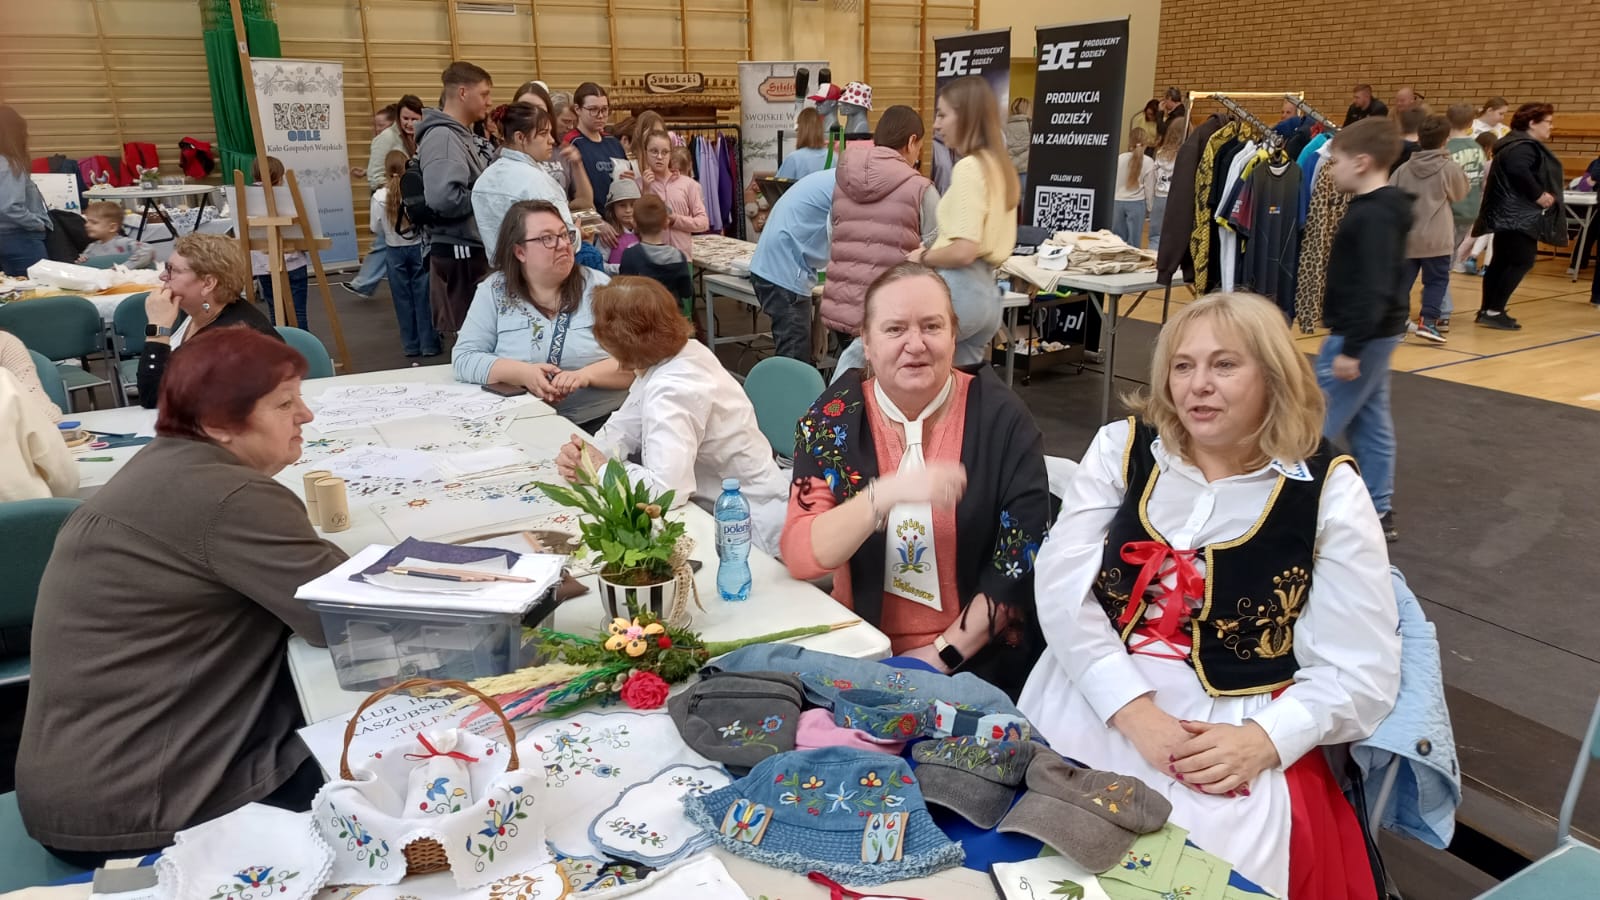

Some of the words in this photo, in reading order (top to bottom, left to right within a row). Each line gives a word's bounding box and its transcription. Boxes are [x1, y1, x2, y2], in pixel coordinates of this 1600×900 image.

[1083, 37, 1121, 47] PRODUCENT
[973, 46, 1004, 55] PRODUCENT
[1045, 91, 1100, 104] PRODUKCJA
[273, 103, 330, 130] KGW
[745, 113, 783, 121] SWOJSKIE
[1050, 110, 1093, 125] ODZIEŻY
[287, 130, 321, 142] ORLE
[1031, 133, 1044, 145] NA
[1045, 131, 1109, 146] ZAMÓWIENIE
[1050, 174, 1072, 182] FOLLOW
